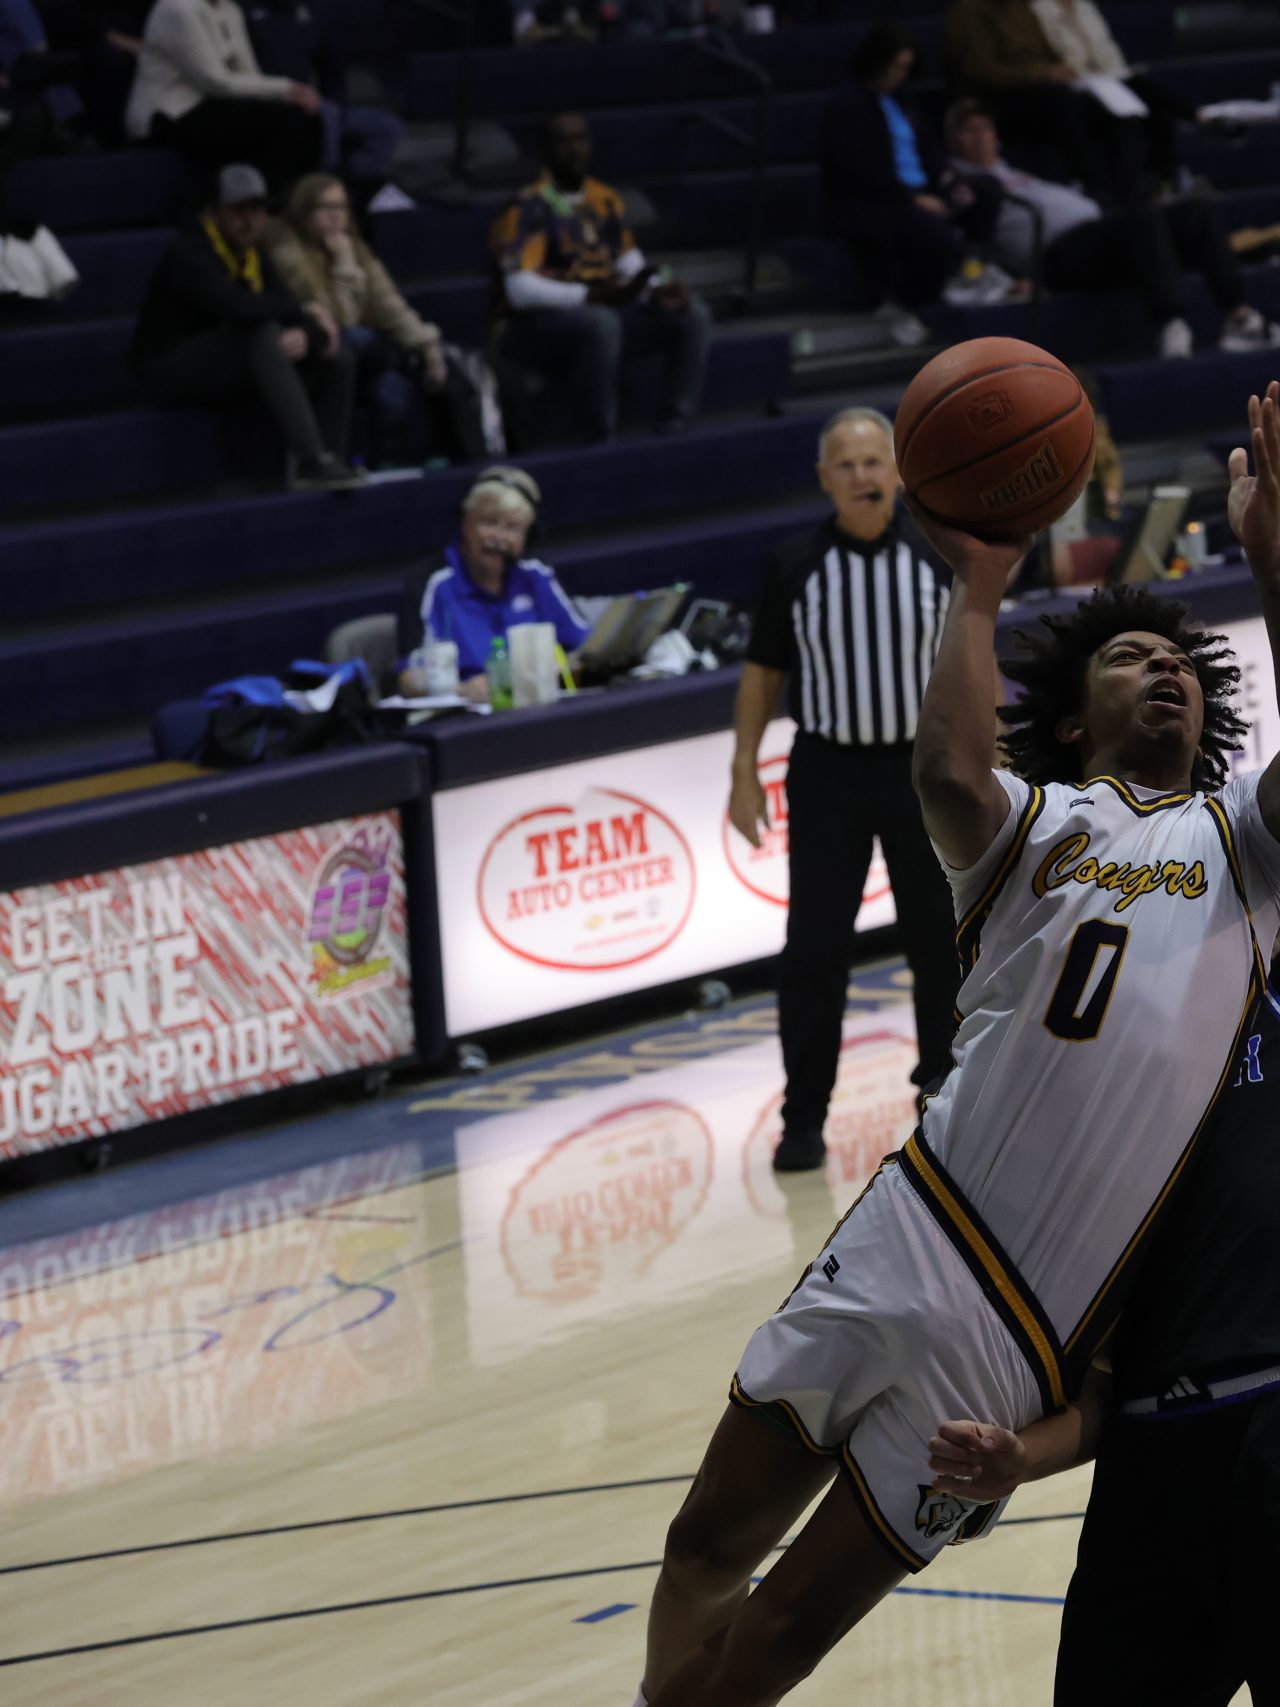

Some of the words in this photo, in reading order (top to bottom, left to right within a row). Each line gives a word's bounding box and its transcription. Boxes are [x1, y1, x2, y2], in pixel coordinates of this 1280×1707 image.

[506, 878, 573, 921] AUTO
[579, 854, 676, 903] CENTER
[525, 810, 650, 880] TEAM
[11, 888, 113, 969] GET
[131, 875, 187, 940] IN
[4, 934, 202, 1065] ZONE
[1043, 918, 1131, 1043] 0
[145, 1008, 300, 1099] PRIDE
